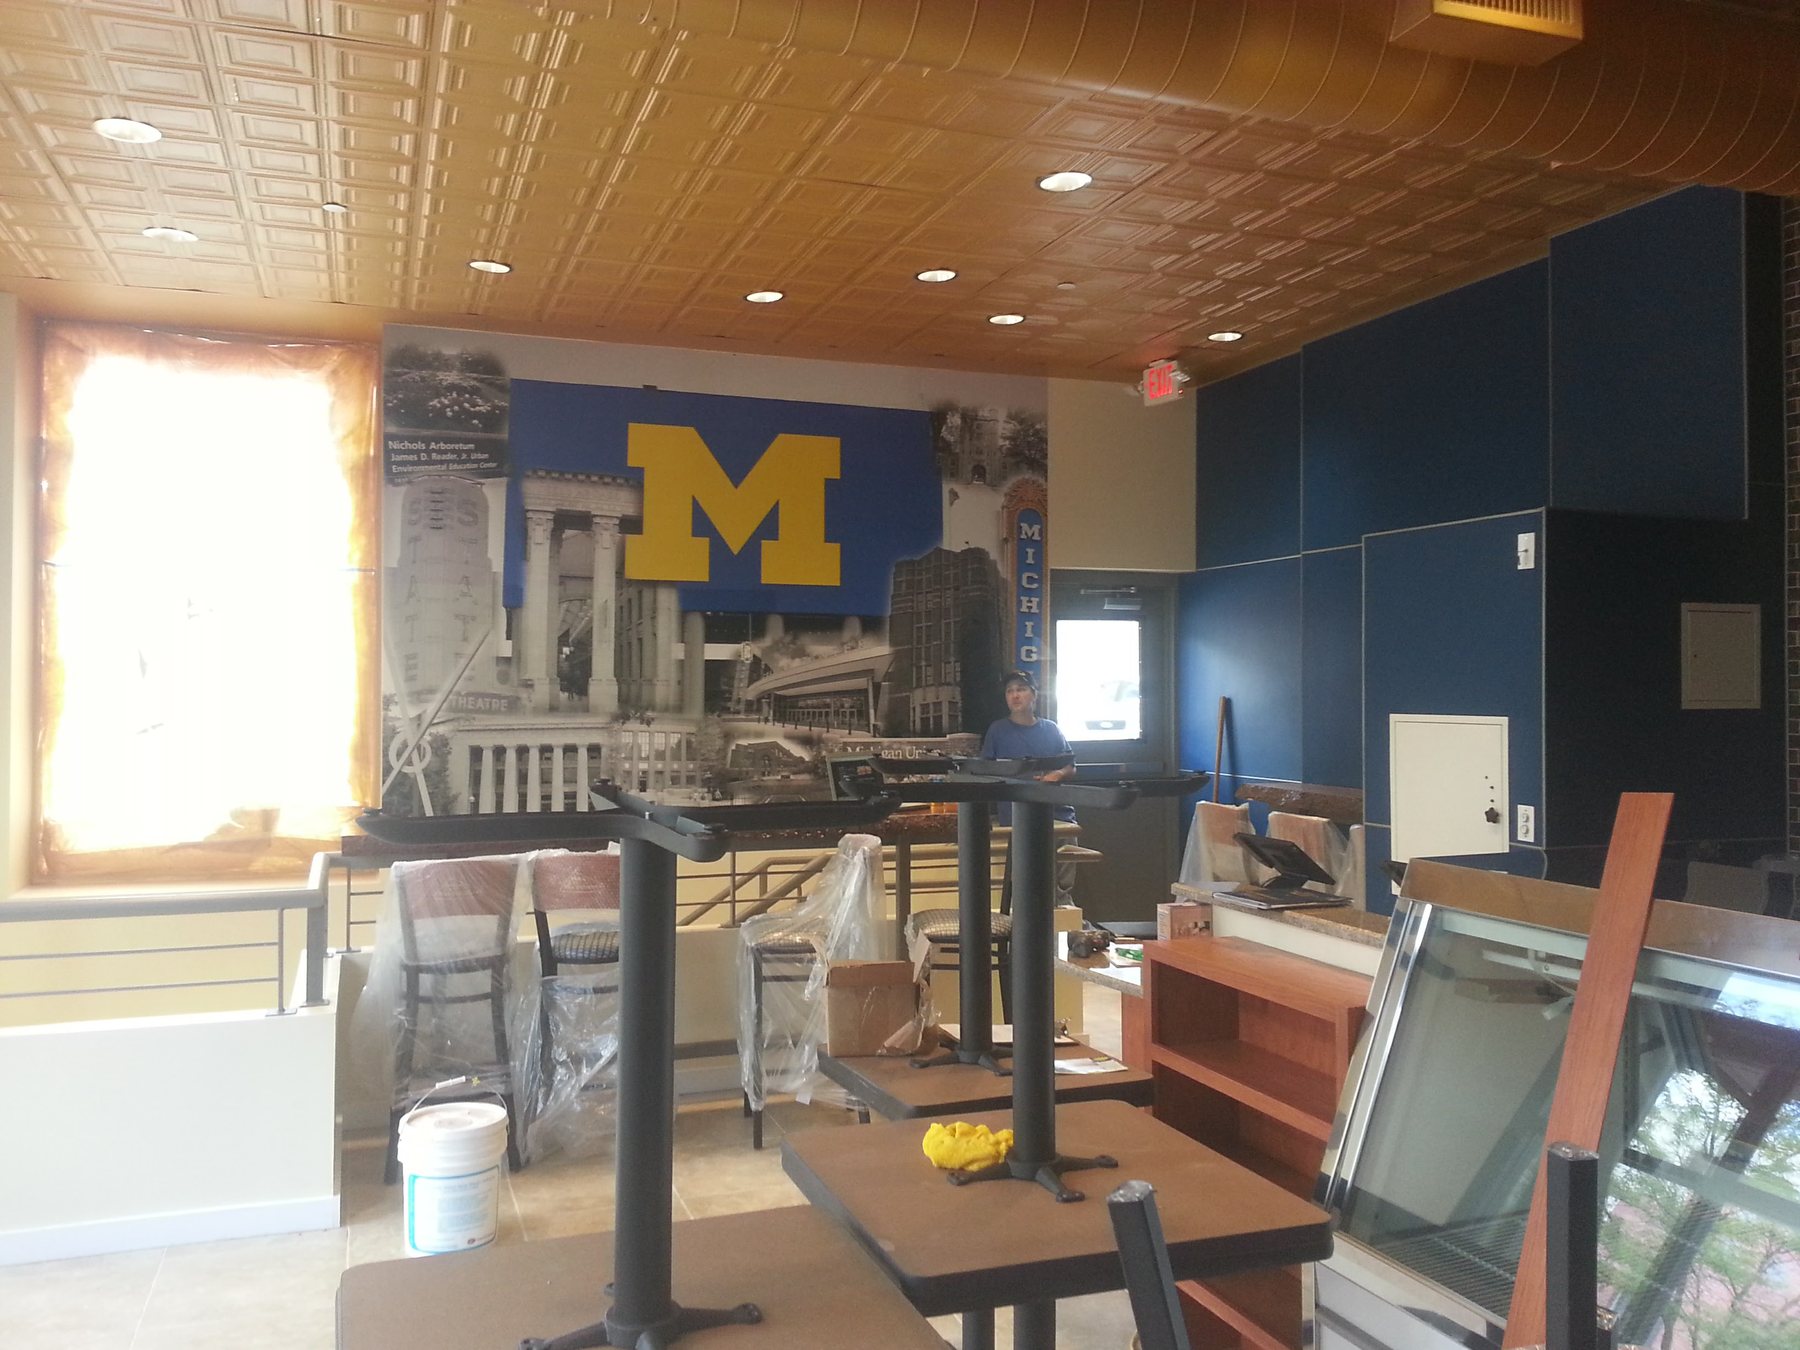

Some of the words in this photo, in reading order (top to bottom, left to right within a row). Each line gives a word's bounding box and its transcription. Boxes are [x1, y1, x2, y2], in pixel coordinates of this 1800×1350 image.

[1148, 363, 1175, 400] EXIT
[388, 440, 426, 450] Nichols
[429, 441, 475, 450] Arboretum
[391, 453, 418, 461] James
[420, 453, 429, 461] D.
[392, 464, 448, 473] Environmental
[448, 463, 479, 471] Education
[479, 461, 498, 469] Center
[625, 422, 841, 587] M
[1020, 522, 1041, 663] MICHIG
